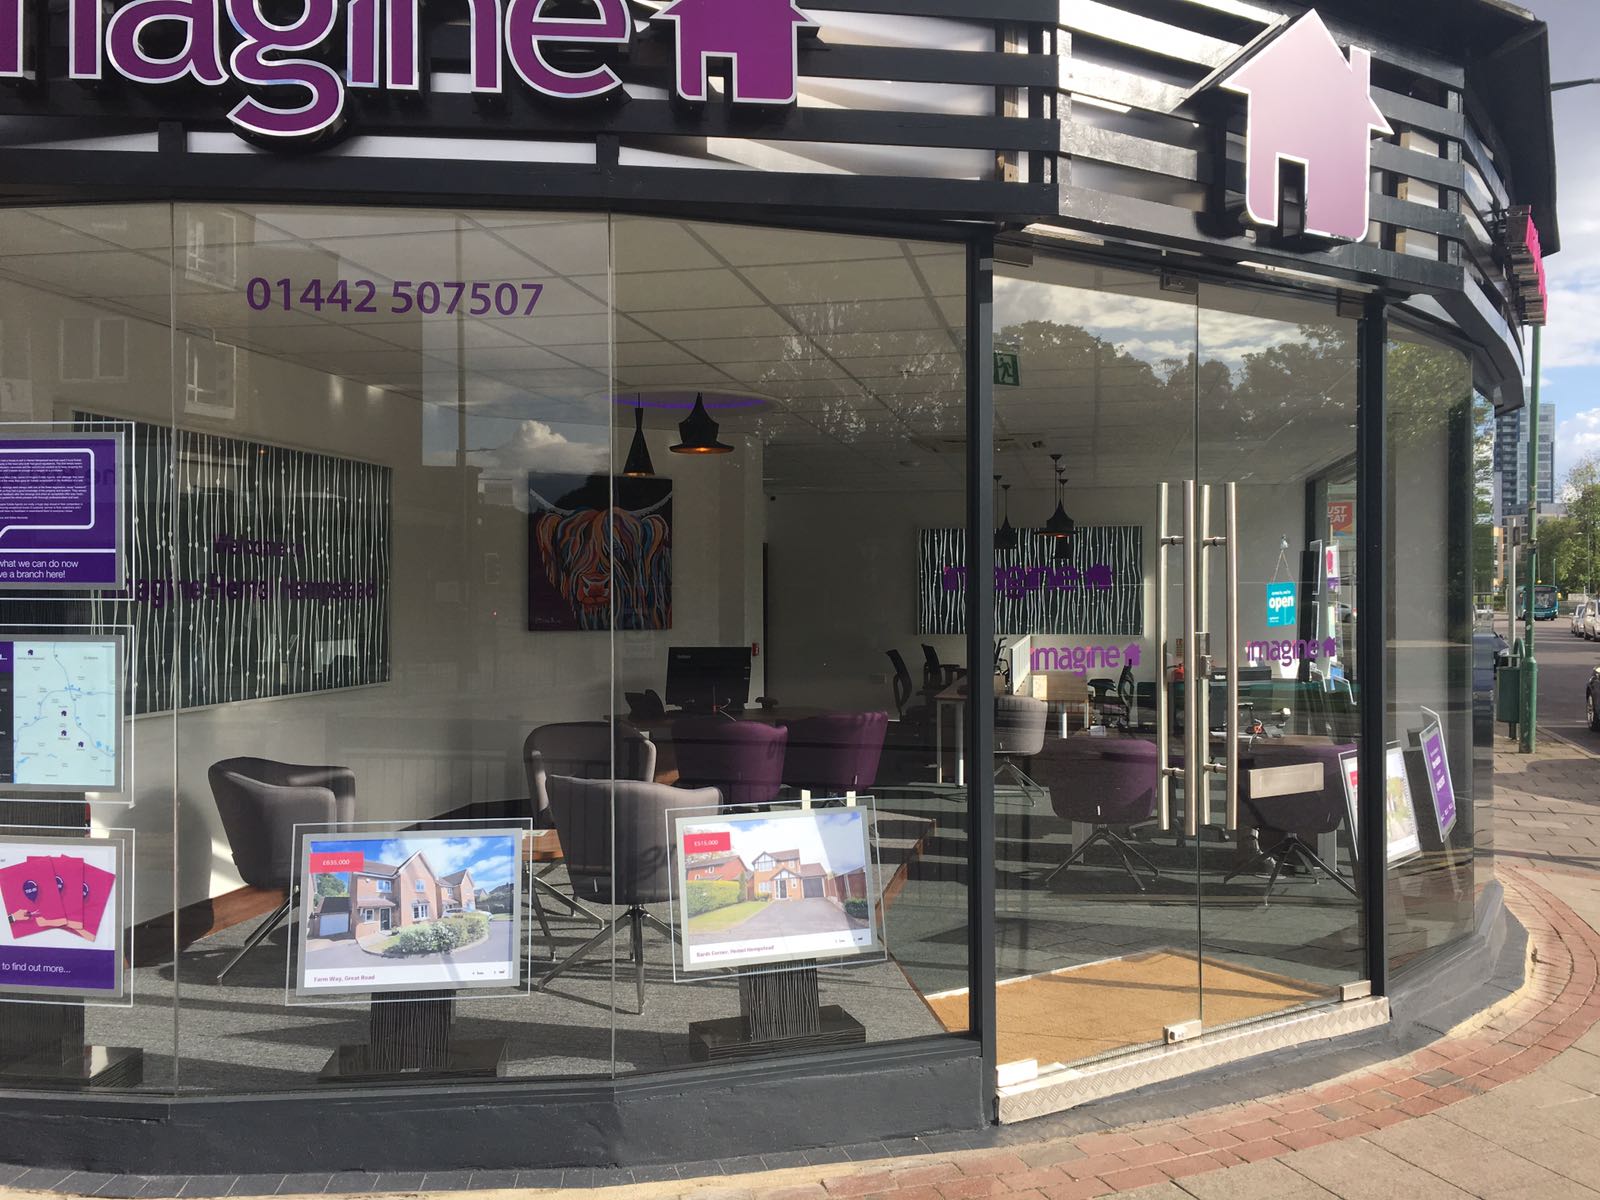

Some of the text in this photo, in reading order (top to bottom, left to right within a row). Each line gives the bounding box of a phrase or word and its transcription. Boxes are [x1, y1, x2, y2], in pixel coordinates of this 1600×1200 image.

[246, 277, 544, 316] 01442 507507
[1327, 505, 1347, 514] UST
[17, 560, 30, 568] we
[31, 560, 47, 568] can
[48, 559, 60, 568] do
[61, 560, 79, 568] now
[16, 569, 44, 579] branch
[45, 569, 66, 579] here!
[1269, 595, 1294, 613] open
[1246, 639, 1320, 667] imagine
[1030, 645, 1121, 677] imagine
[2, 962, 11, 970] to
[12, 962, 27, 971] find
[28, 964, 41, 972] out
